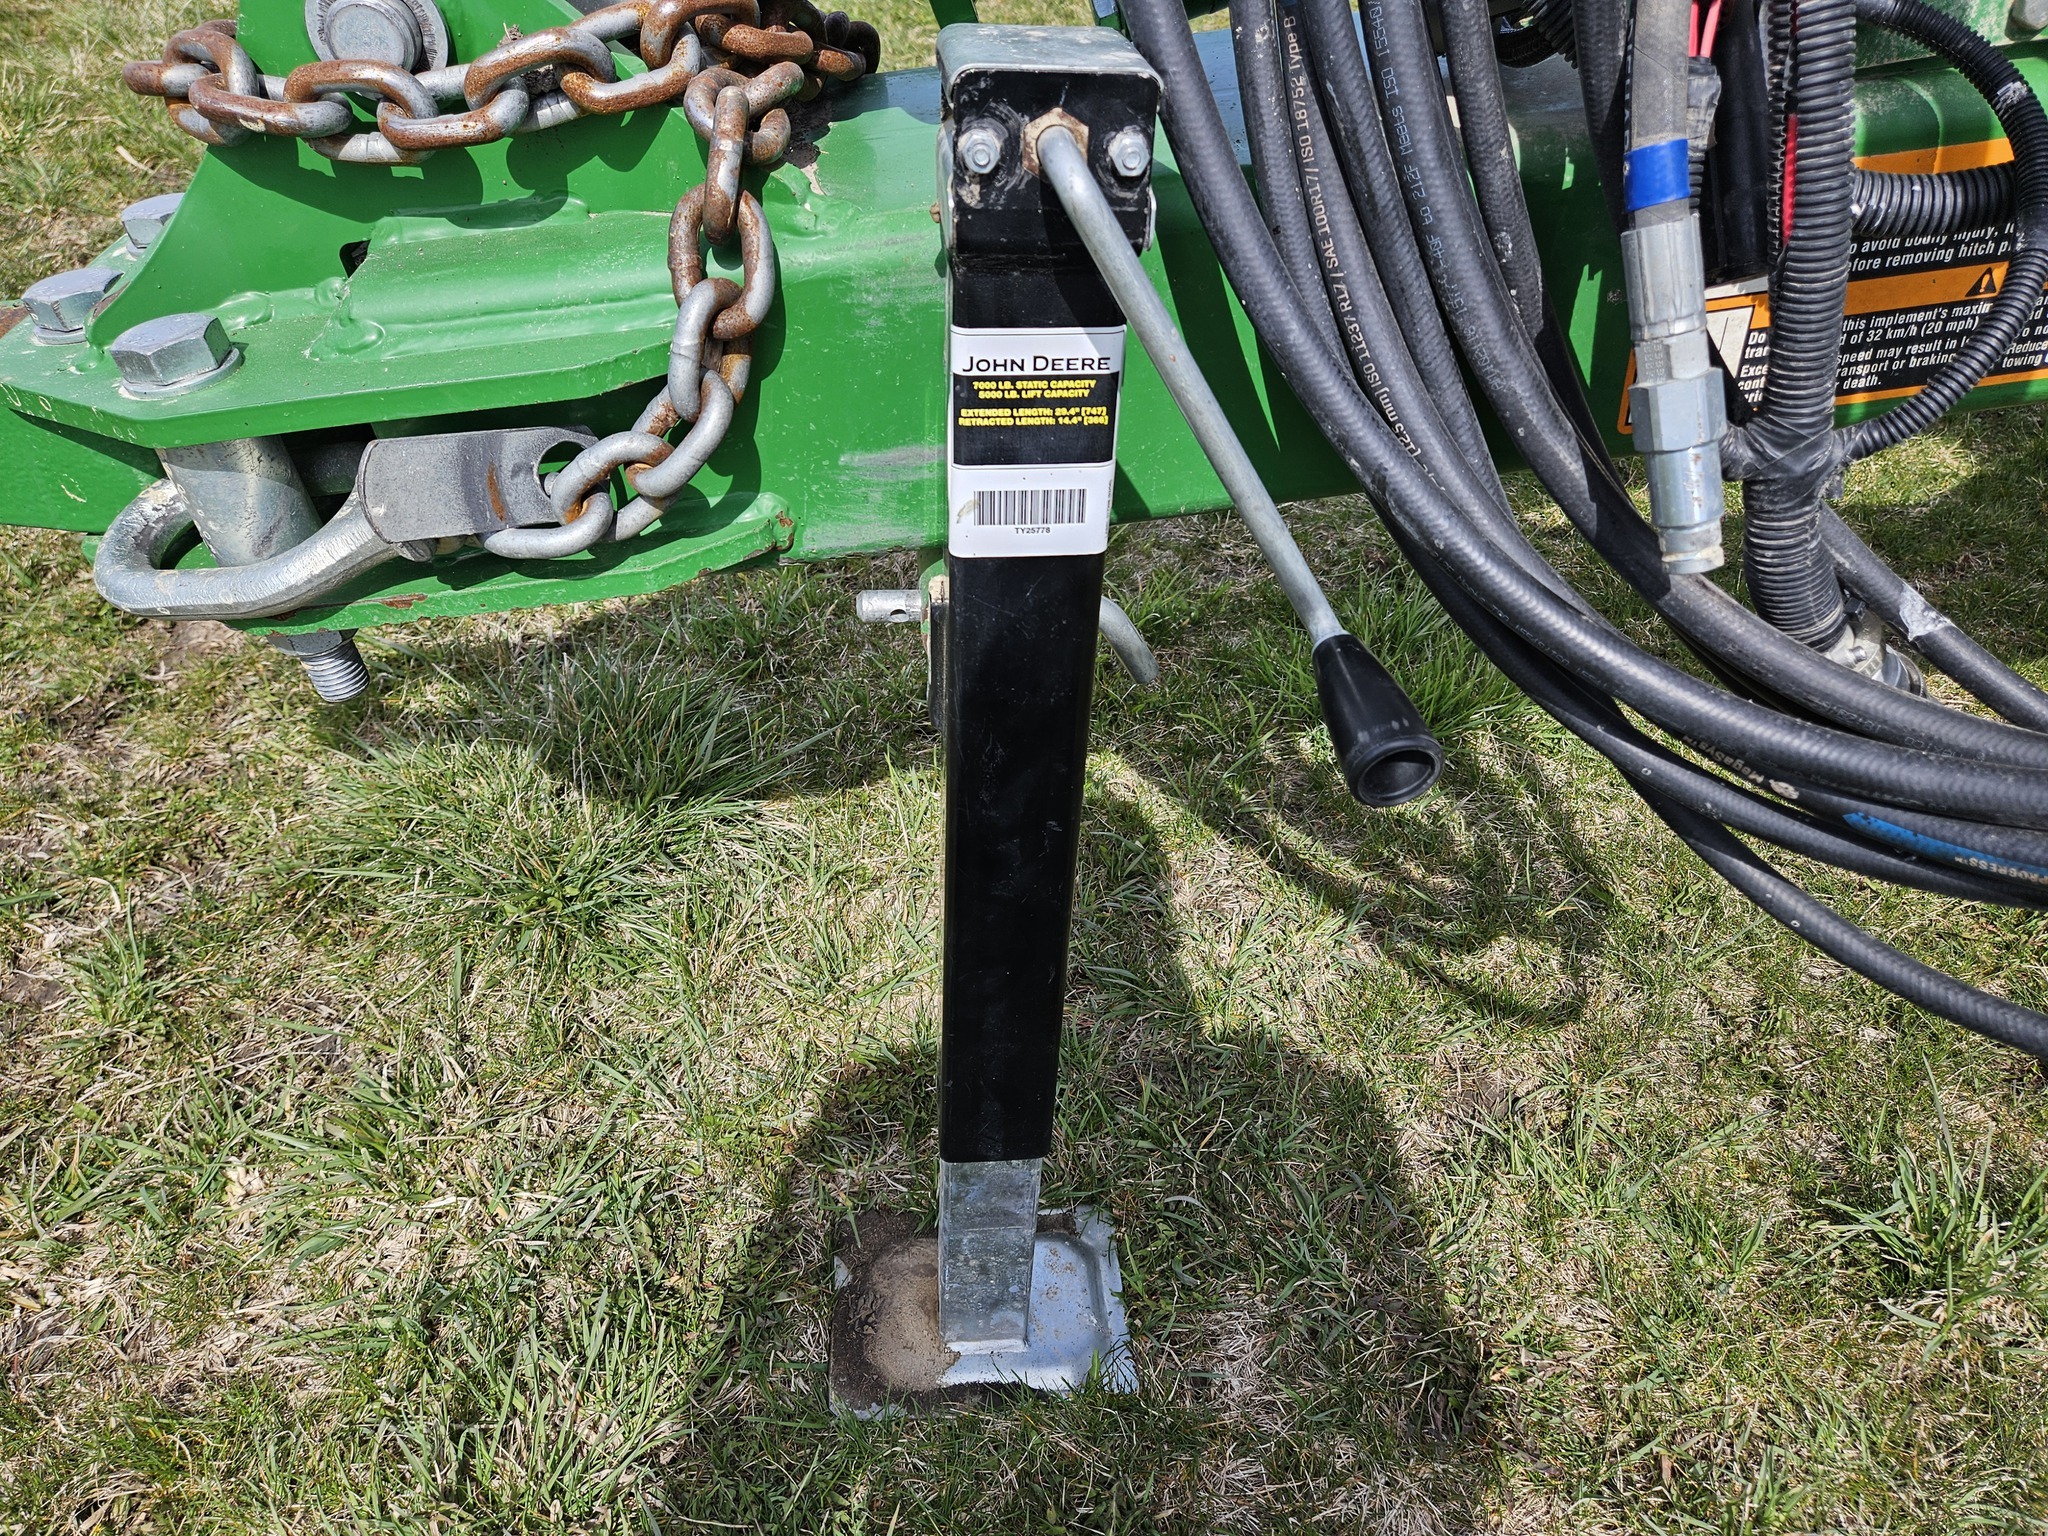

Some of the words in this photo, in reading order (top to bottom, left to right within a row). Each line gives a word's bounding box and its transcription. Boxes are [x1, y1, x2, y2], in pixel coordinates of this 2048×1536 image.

[1283, 16, 1296, 28] B
[1288, 33, 1303, 73] Type
[1381, 67, 1399, 99] ISO
[1290, 77, 1309, 131] 18752
[1392, 105, 1413, 156] Meets
[1299, 135, 1315, 163] ISO
[1404, 164, 1426, 200] 212F
[1420, 206, 1433, 225] to
[1321, 237, 1339, 269] SAE
[1848, 257, 1881, 272] efore
[1885, 247, 1954, 268] removing
[1958, 240, 1995, 258] hitch
[1849, 243, 1858, 254] o
[1861, 238, 1901, 253] avoid
[1344, 316, 1371, 361] 11237
[1748, 331, 1767, 345] Do
[1842, 318, 1867, 332] this
[1869, 307, 1948, 329] implement's
[1850, 331, 1864, 345] of
[1866, 329, 1883, 343] 32
[1886, 324, 1917, 340] km/h
[1921, 320, 1943, 337] (20
[1945, 316, 1979, 333] mph)
[962, 356, 1025, 372] JOHN
[1033, 355, 1111, 372] DEERE
[1740, 364, 1769, 378] Exce
[1876, 346, 1903, 359] may
[1905, 339, 1942, 355] result
[1945, 338, 1957, 349] in
[2002, 353, 2043, 368] towing
[972, 381, 997, 390] 7000
[998, 381, 1014, 390] LB.
[1015, 380, 1049, 389] STATIC
[1050, 379, 1097, 389] CAPACITY
[1362, 363, 1382, 388] ISO
[1738, 375, 1766, 391] cont
[1835, 360, 1889, 377] ransport
[1892, 359, 1906, 370] or
[1843, 374, 1882, 390] death.
[978, 390, 1003, 399] 5000
[1004, 390, 1020, 399] LB.
[1021, 389, 1043, 399] LIFT
[1043, 389, 1091, 398] CAPACITY
[958, 417, 1014, 426] RETRACTED
[1015, 416, 1056, 426] LENGTH:
[960, 408, 1012, 417] EXTENDED
[1013, 408, 1053, 417] LENGTH:
[1015, 526, 1051, 535] TY25778
